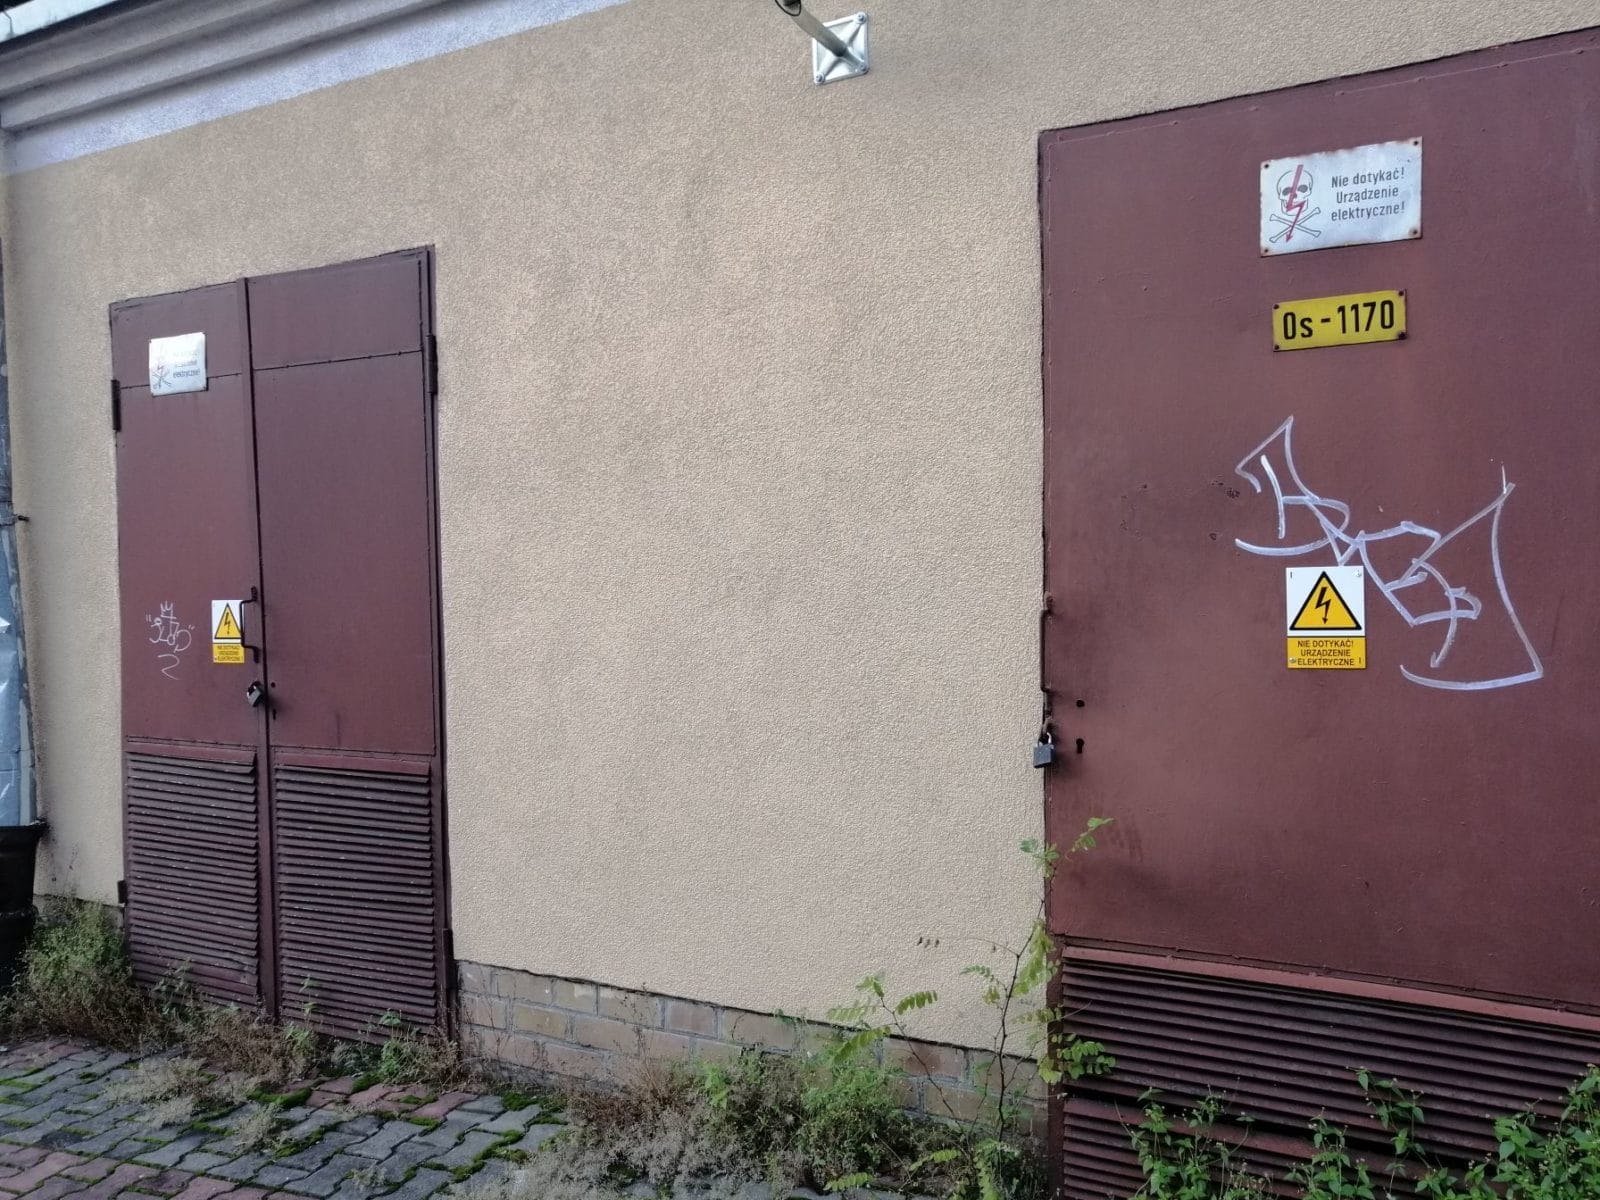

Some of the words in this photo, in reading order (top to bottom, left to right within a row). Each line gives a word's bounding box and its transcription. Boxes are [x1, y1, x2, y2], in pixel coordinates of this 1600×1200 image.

[1331, 175, 1349, 188] Nie
[1352, 166, 1405, 185] dotykać!
[1336, 185, 1399, 204] Urządzenie
[1331, 201, 1405, 221] elektryczne!
[1297, 640, 1311, 648] NIE
